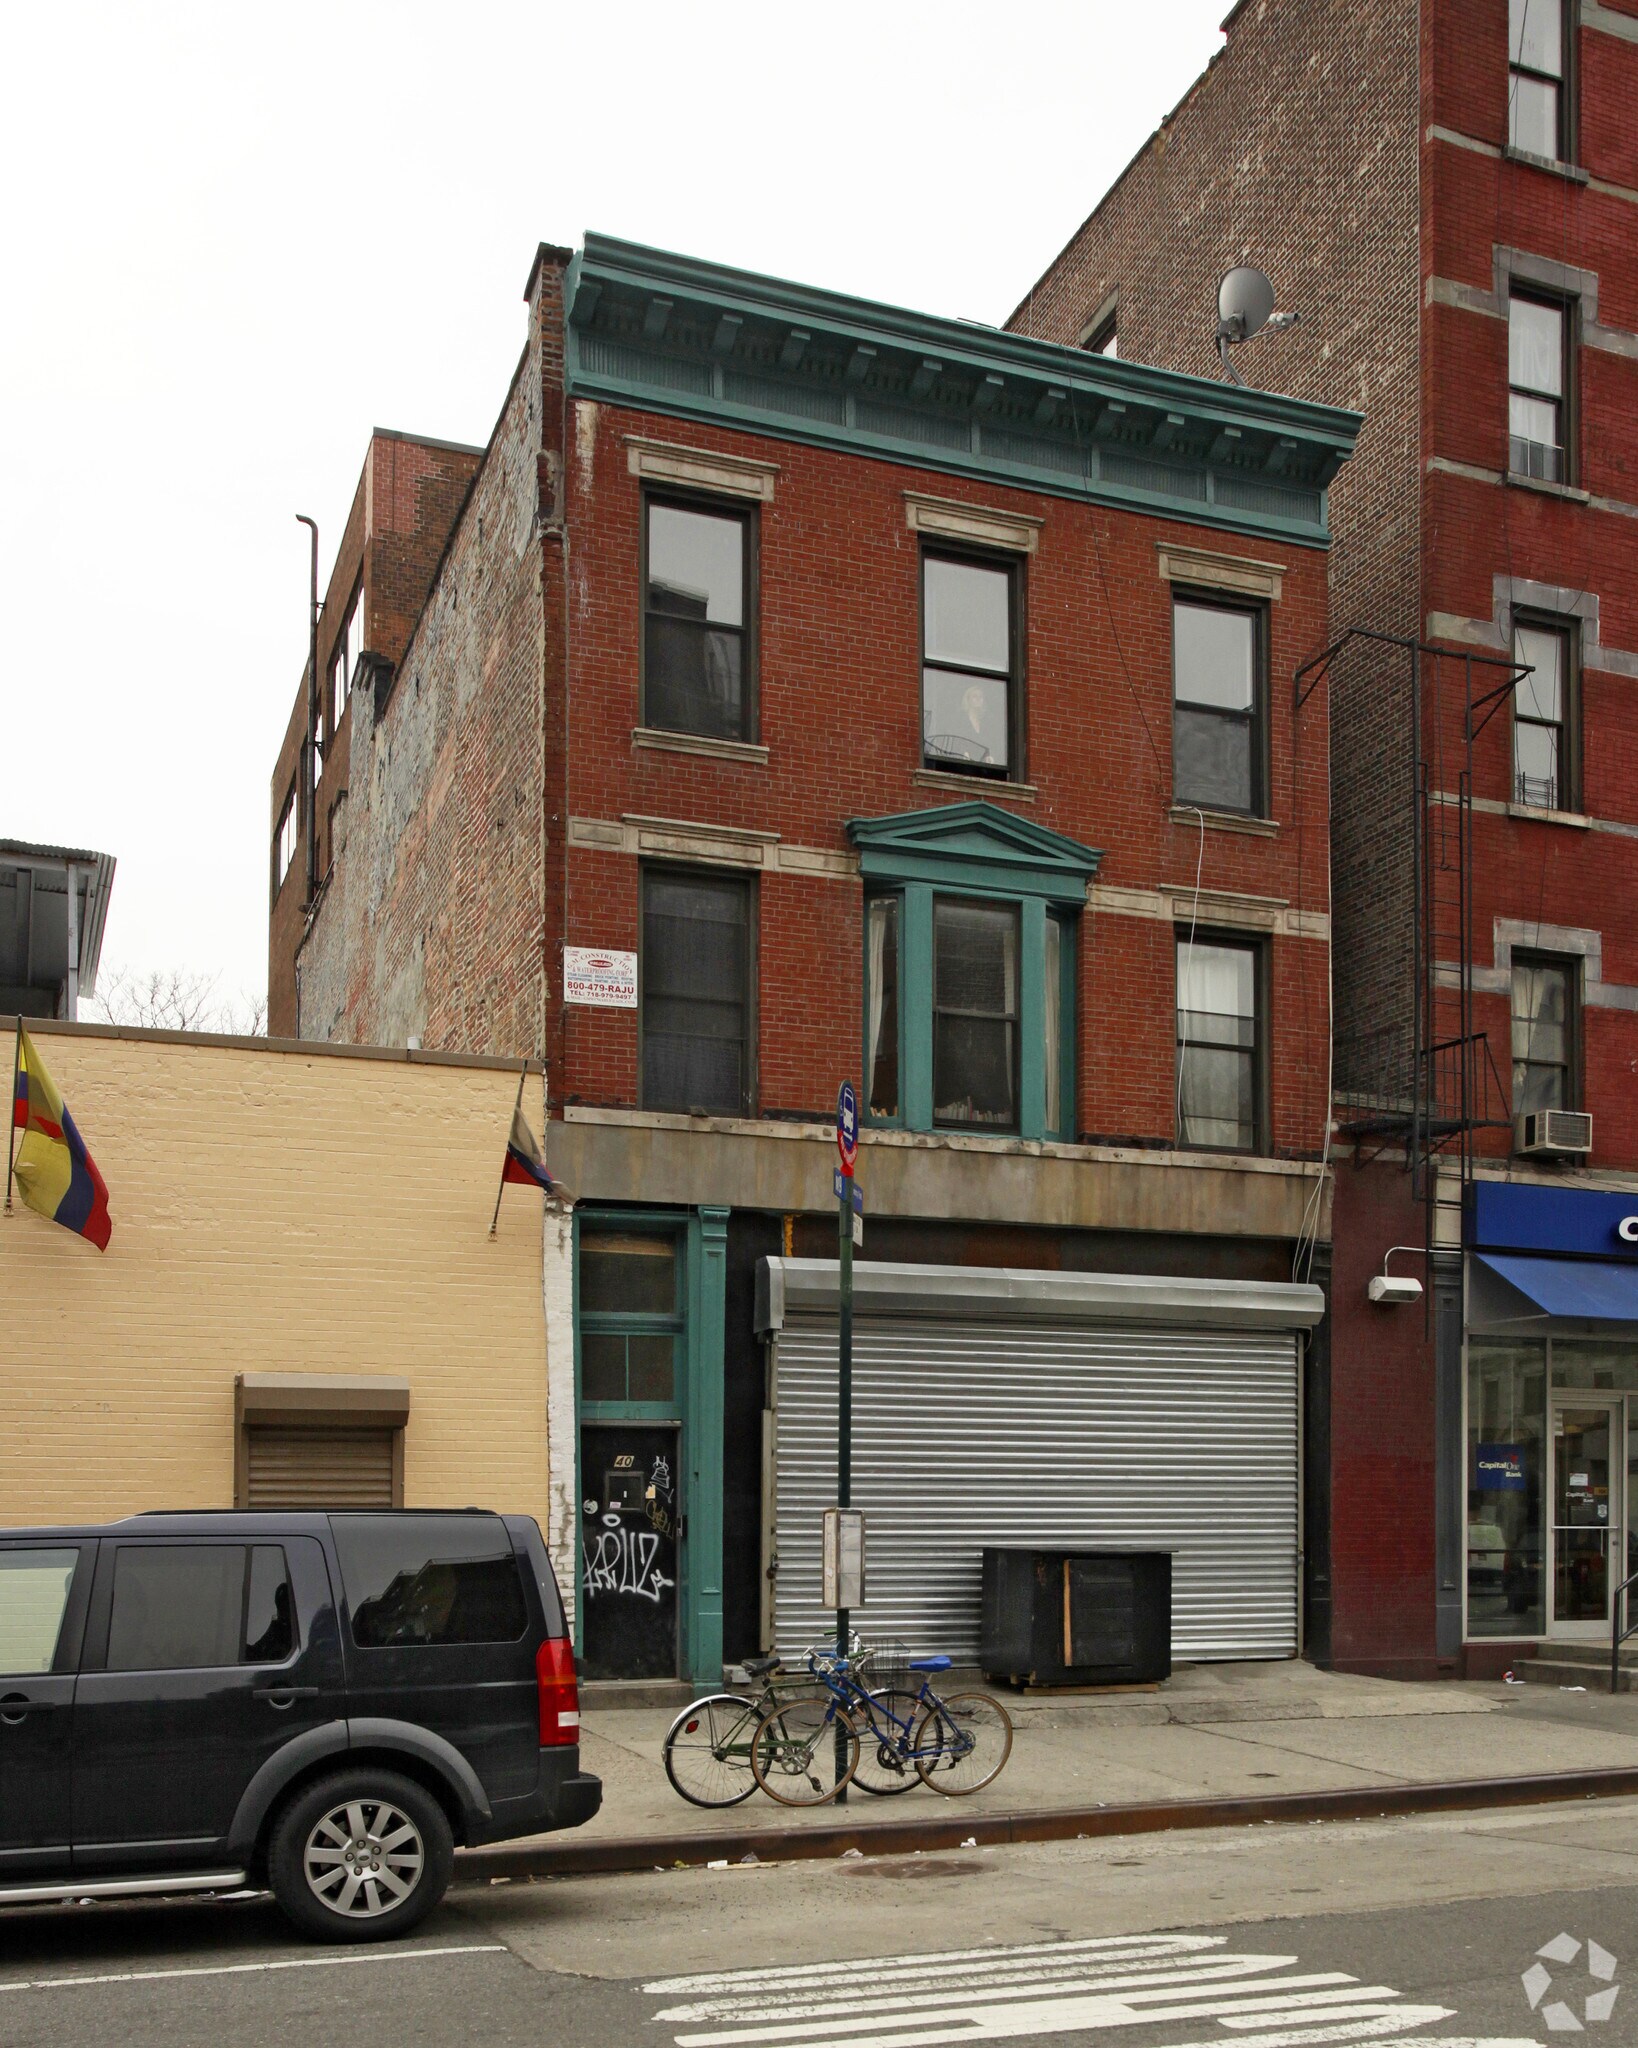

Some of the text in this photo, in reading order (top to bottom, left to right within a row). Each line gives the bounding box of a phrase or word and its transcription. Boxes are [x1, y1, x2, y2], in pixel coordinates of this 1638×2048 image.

[580, 953, 633, 974] CONSTRUCTION
[567, 981, 634, 994] 800-479-RAJU
[587, 992, 632, 1000] 718-979-9497
[615, 1456, 632, 1467] 40
